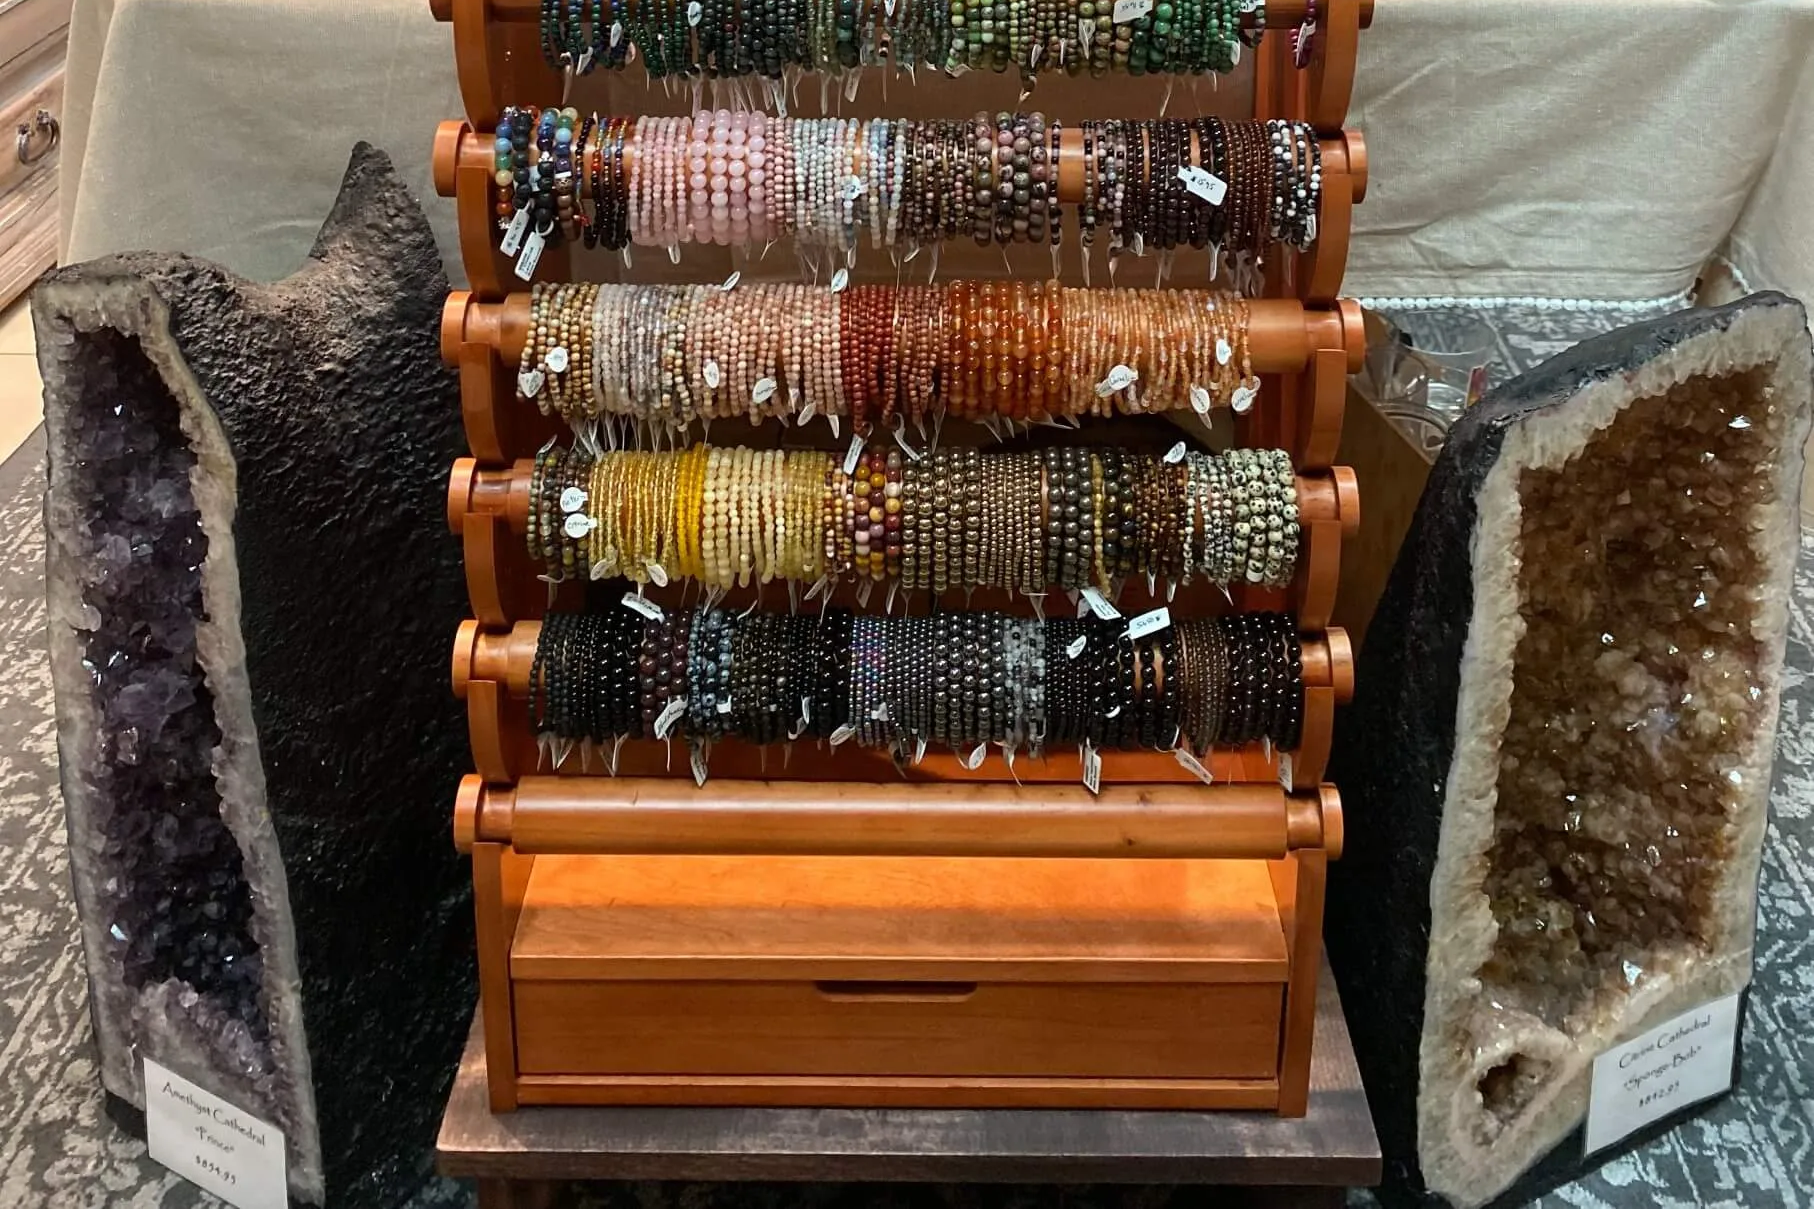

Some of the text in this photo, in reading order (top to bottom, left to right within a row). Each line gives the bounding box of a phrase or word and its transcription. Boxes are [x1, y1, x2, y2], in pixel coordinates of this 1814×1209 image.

[1657, 1014, 1710, 1048] Cathedral
[162, 1082, 265, 1146] Amethyst Cathedral
